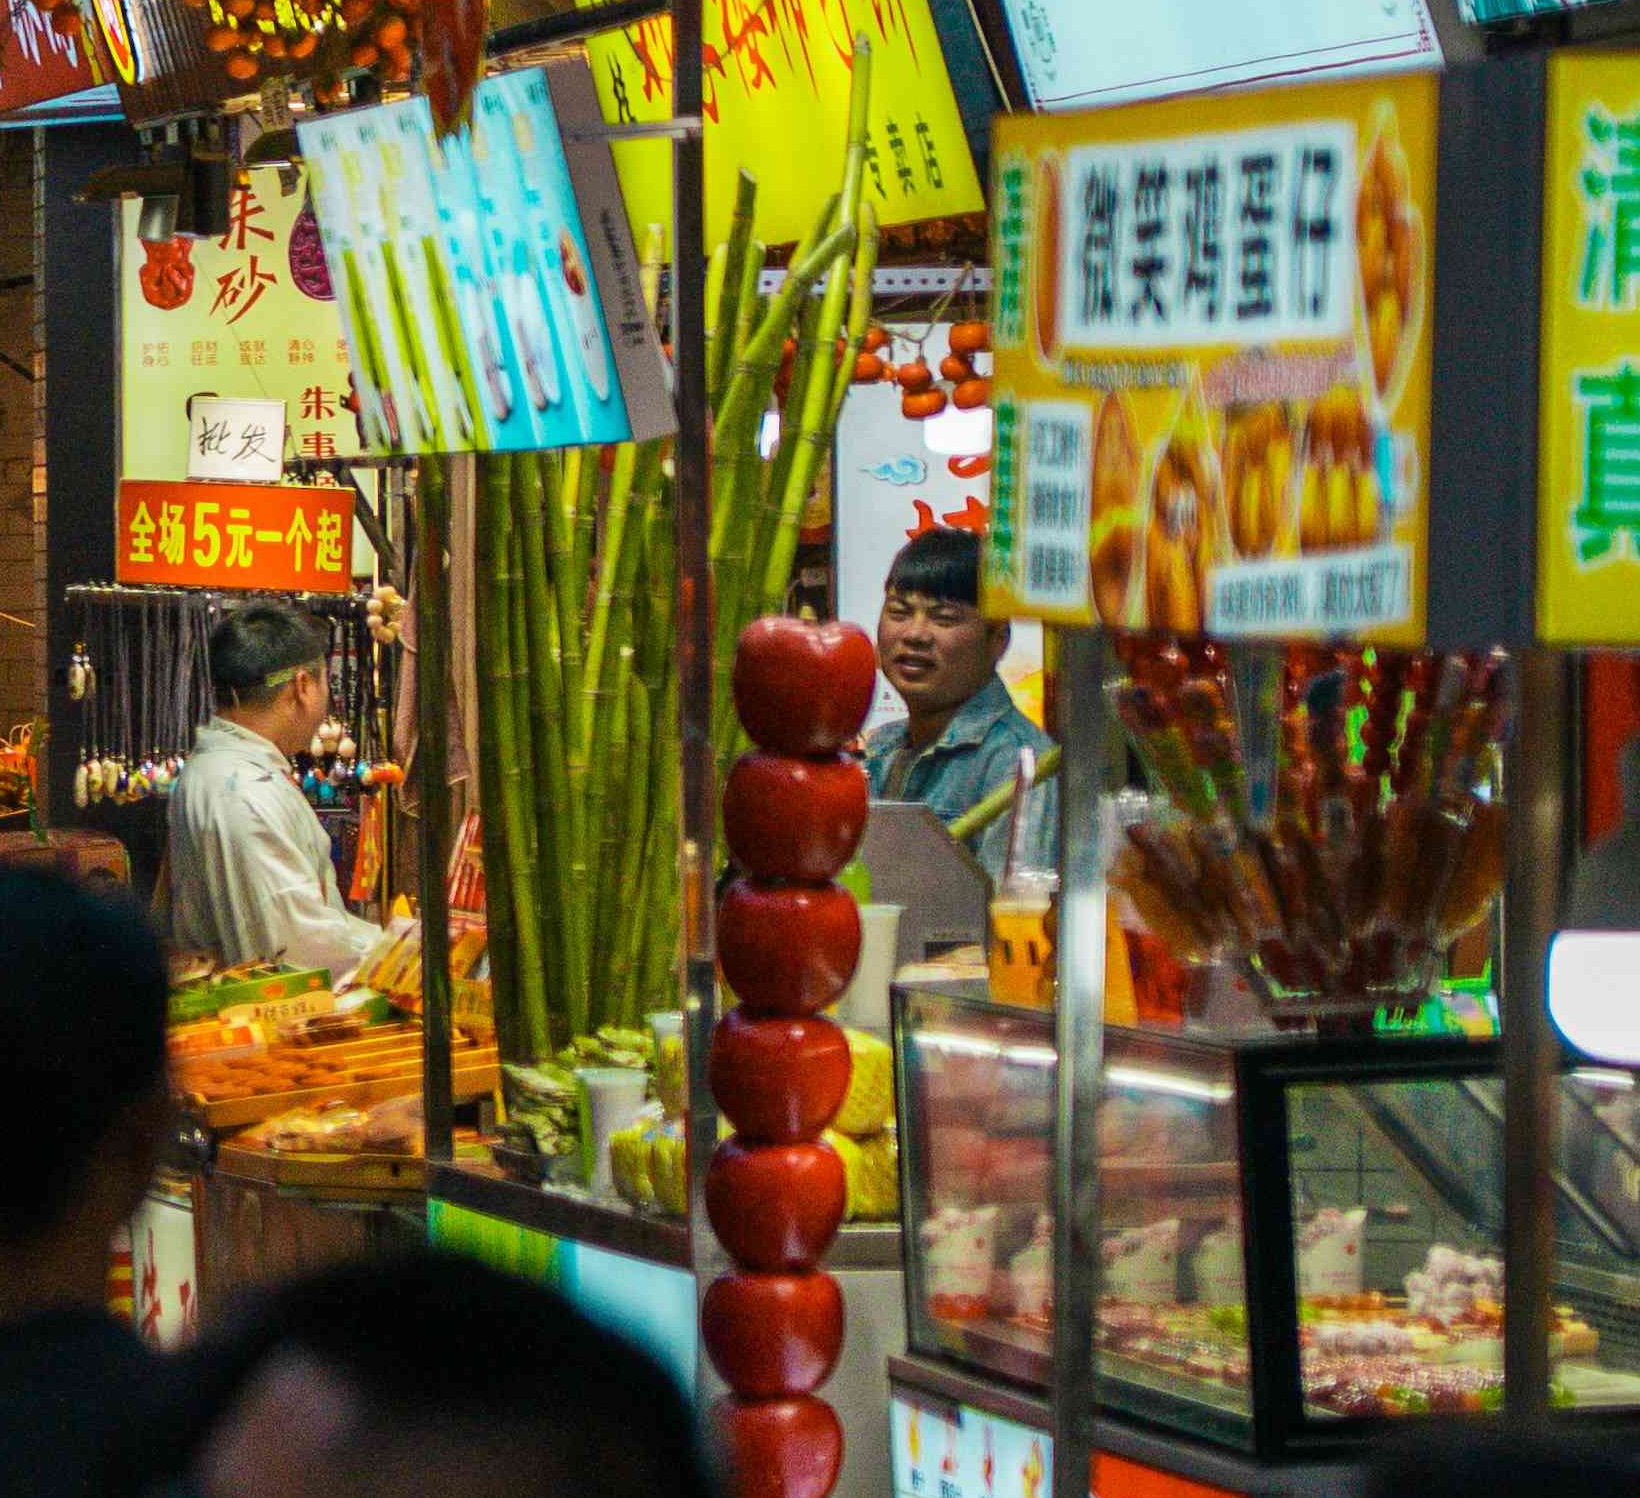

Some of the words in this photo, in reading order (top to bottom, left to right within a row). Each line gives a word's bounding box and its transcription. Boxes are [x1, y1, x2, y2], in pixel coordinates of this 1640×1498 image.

[1081, 143, 1340, 327] 微笑鸡蛋仔
[129, 501, 344, 573] 全场5元一个起
